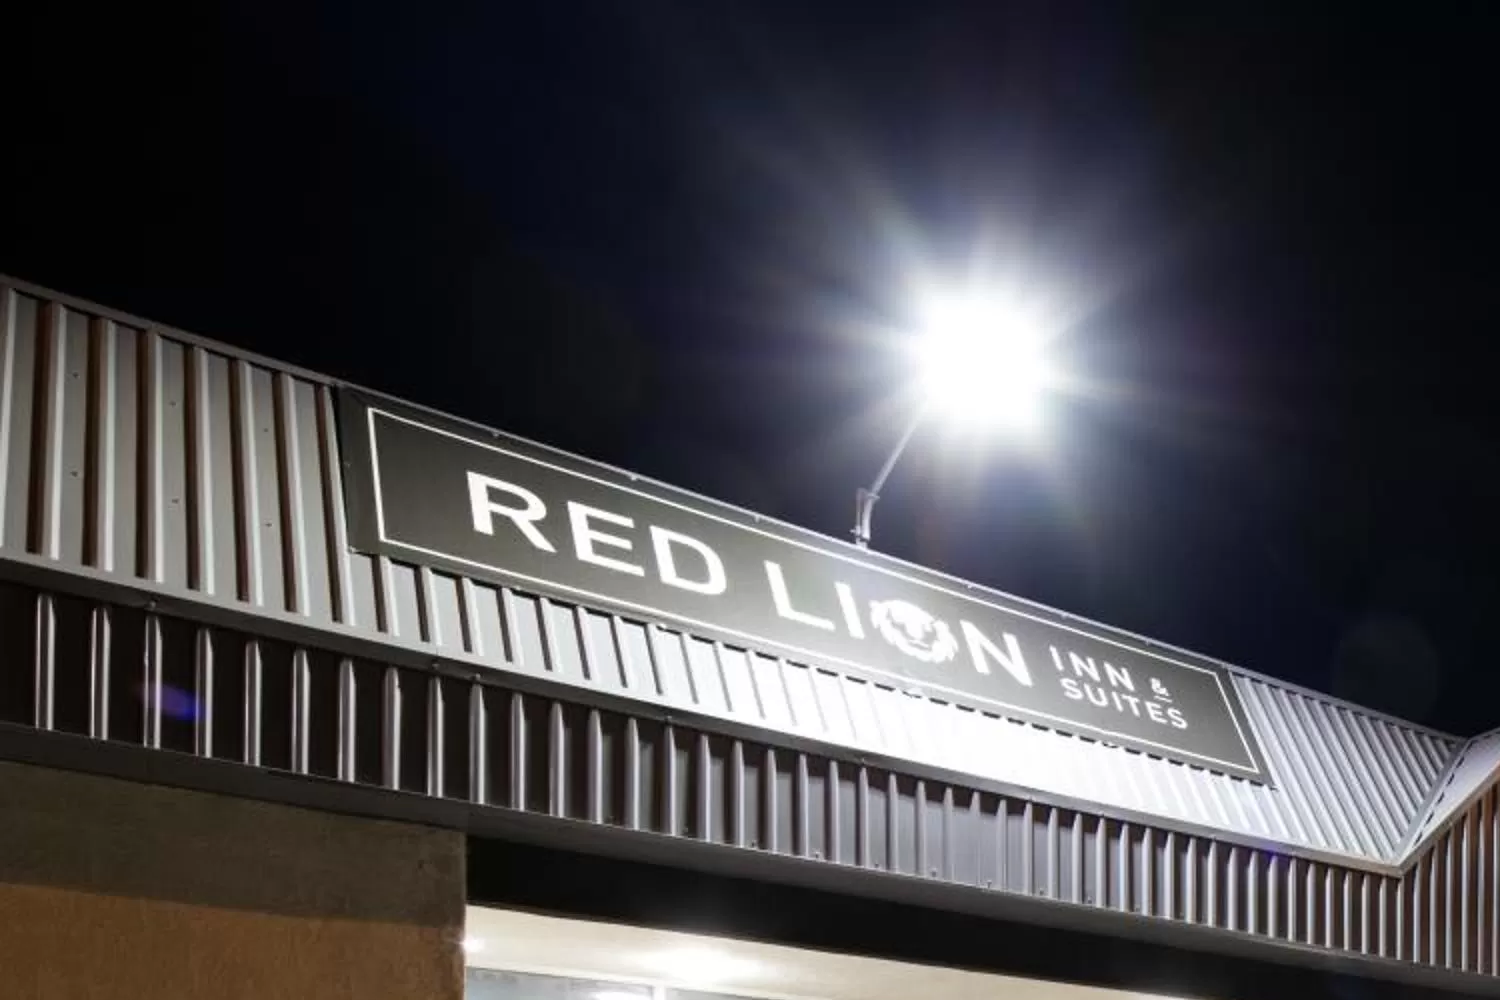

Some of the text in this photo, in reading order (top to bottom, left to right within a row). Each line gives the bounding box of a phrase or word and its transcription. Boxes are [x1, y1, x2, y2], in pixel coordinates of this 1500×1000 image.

[465, 470, 728, 597] RED
[1049, 644, 1171, 698] INN &
[1059, 677, 1189, 730] SUITES
